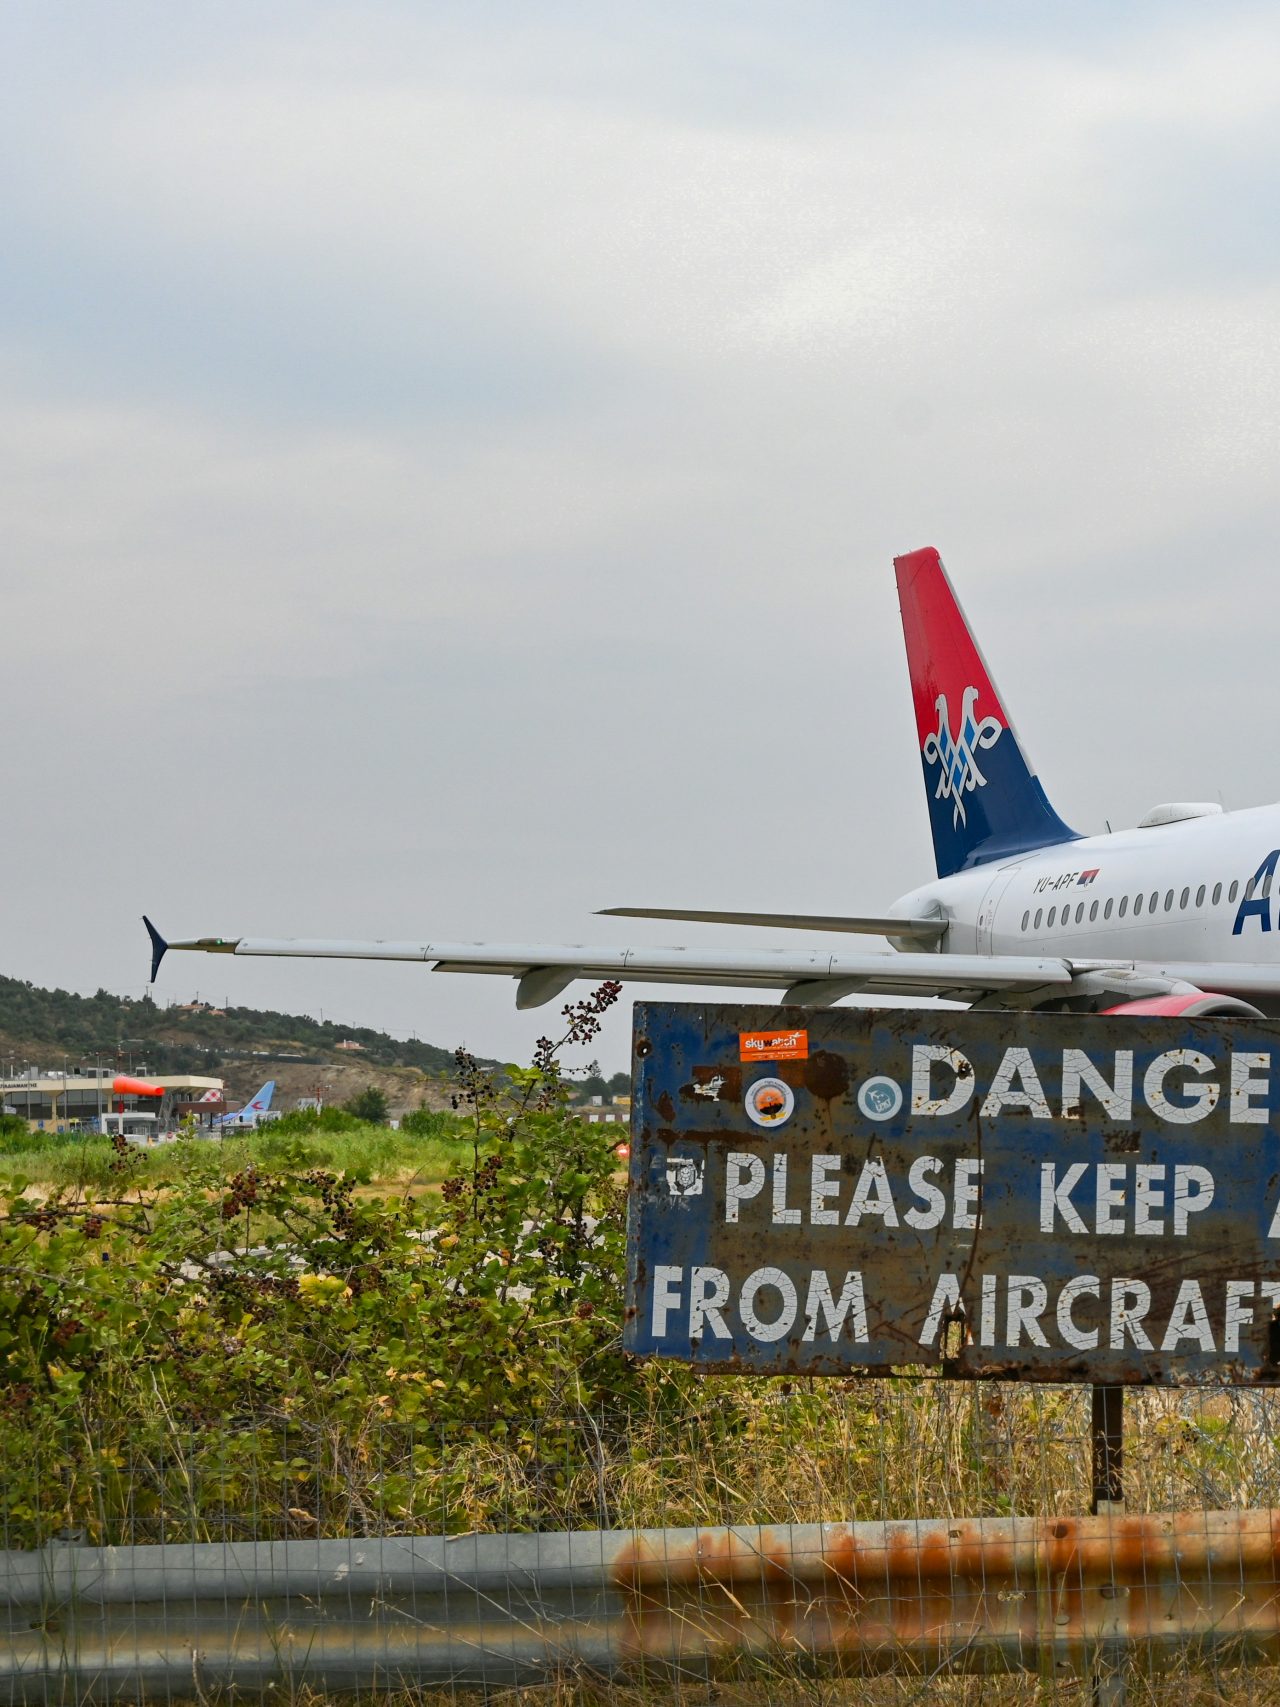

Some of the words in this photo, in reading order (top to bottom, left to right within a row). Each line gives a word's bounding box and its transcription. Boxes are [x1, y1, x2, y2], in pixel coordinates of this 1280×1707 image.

[1033, 872, 1079, 894] YU-APF
[726, 1152, 985, 1230] PLEASE
[1040, 1162, 1215, 1236] KEEP
[652, 1265, 870, 1343] FROM
